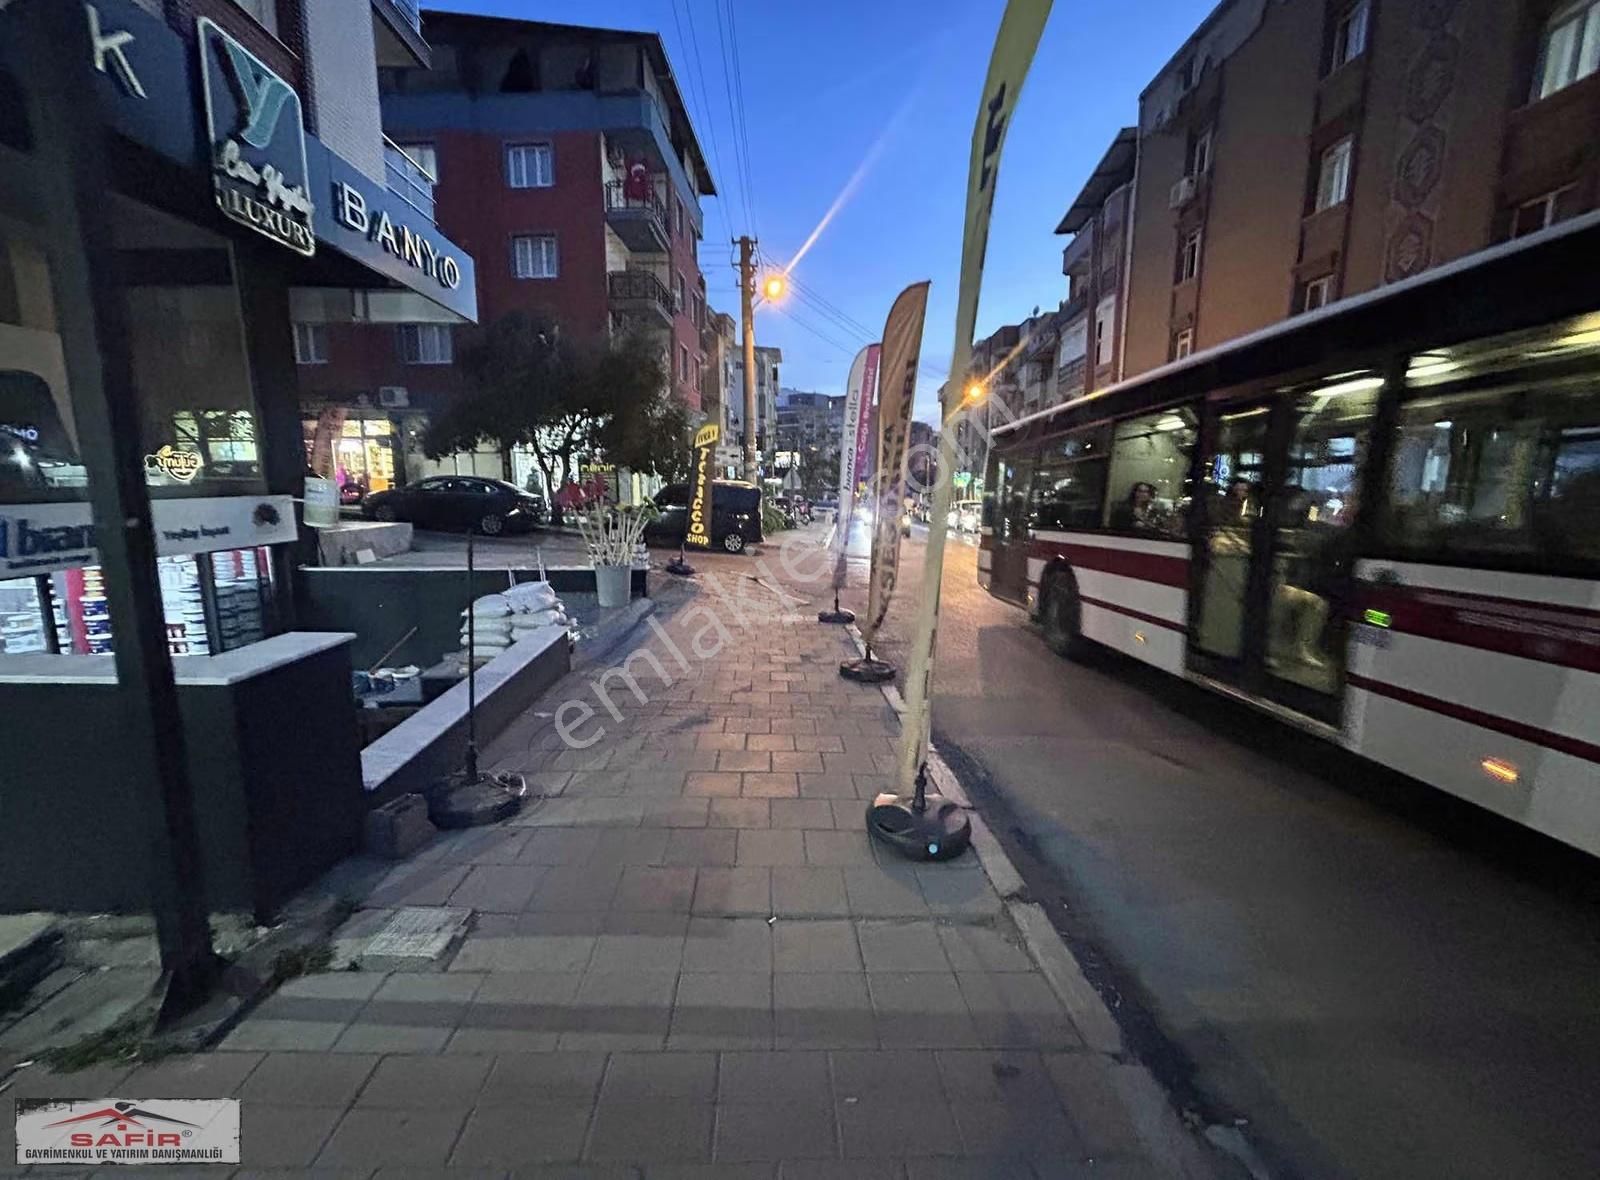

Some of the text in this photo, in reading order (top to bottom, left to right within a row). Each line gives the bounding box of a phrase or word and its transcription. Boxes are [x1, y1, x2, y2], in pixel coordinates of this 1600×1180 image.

[230, 188, 315, 247] LUXURY
[341, 181, 460, 289] BANYO
[686, 533, 709, 545] SHOP
